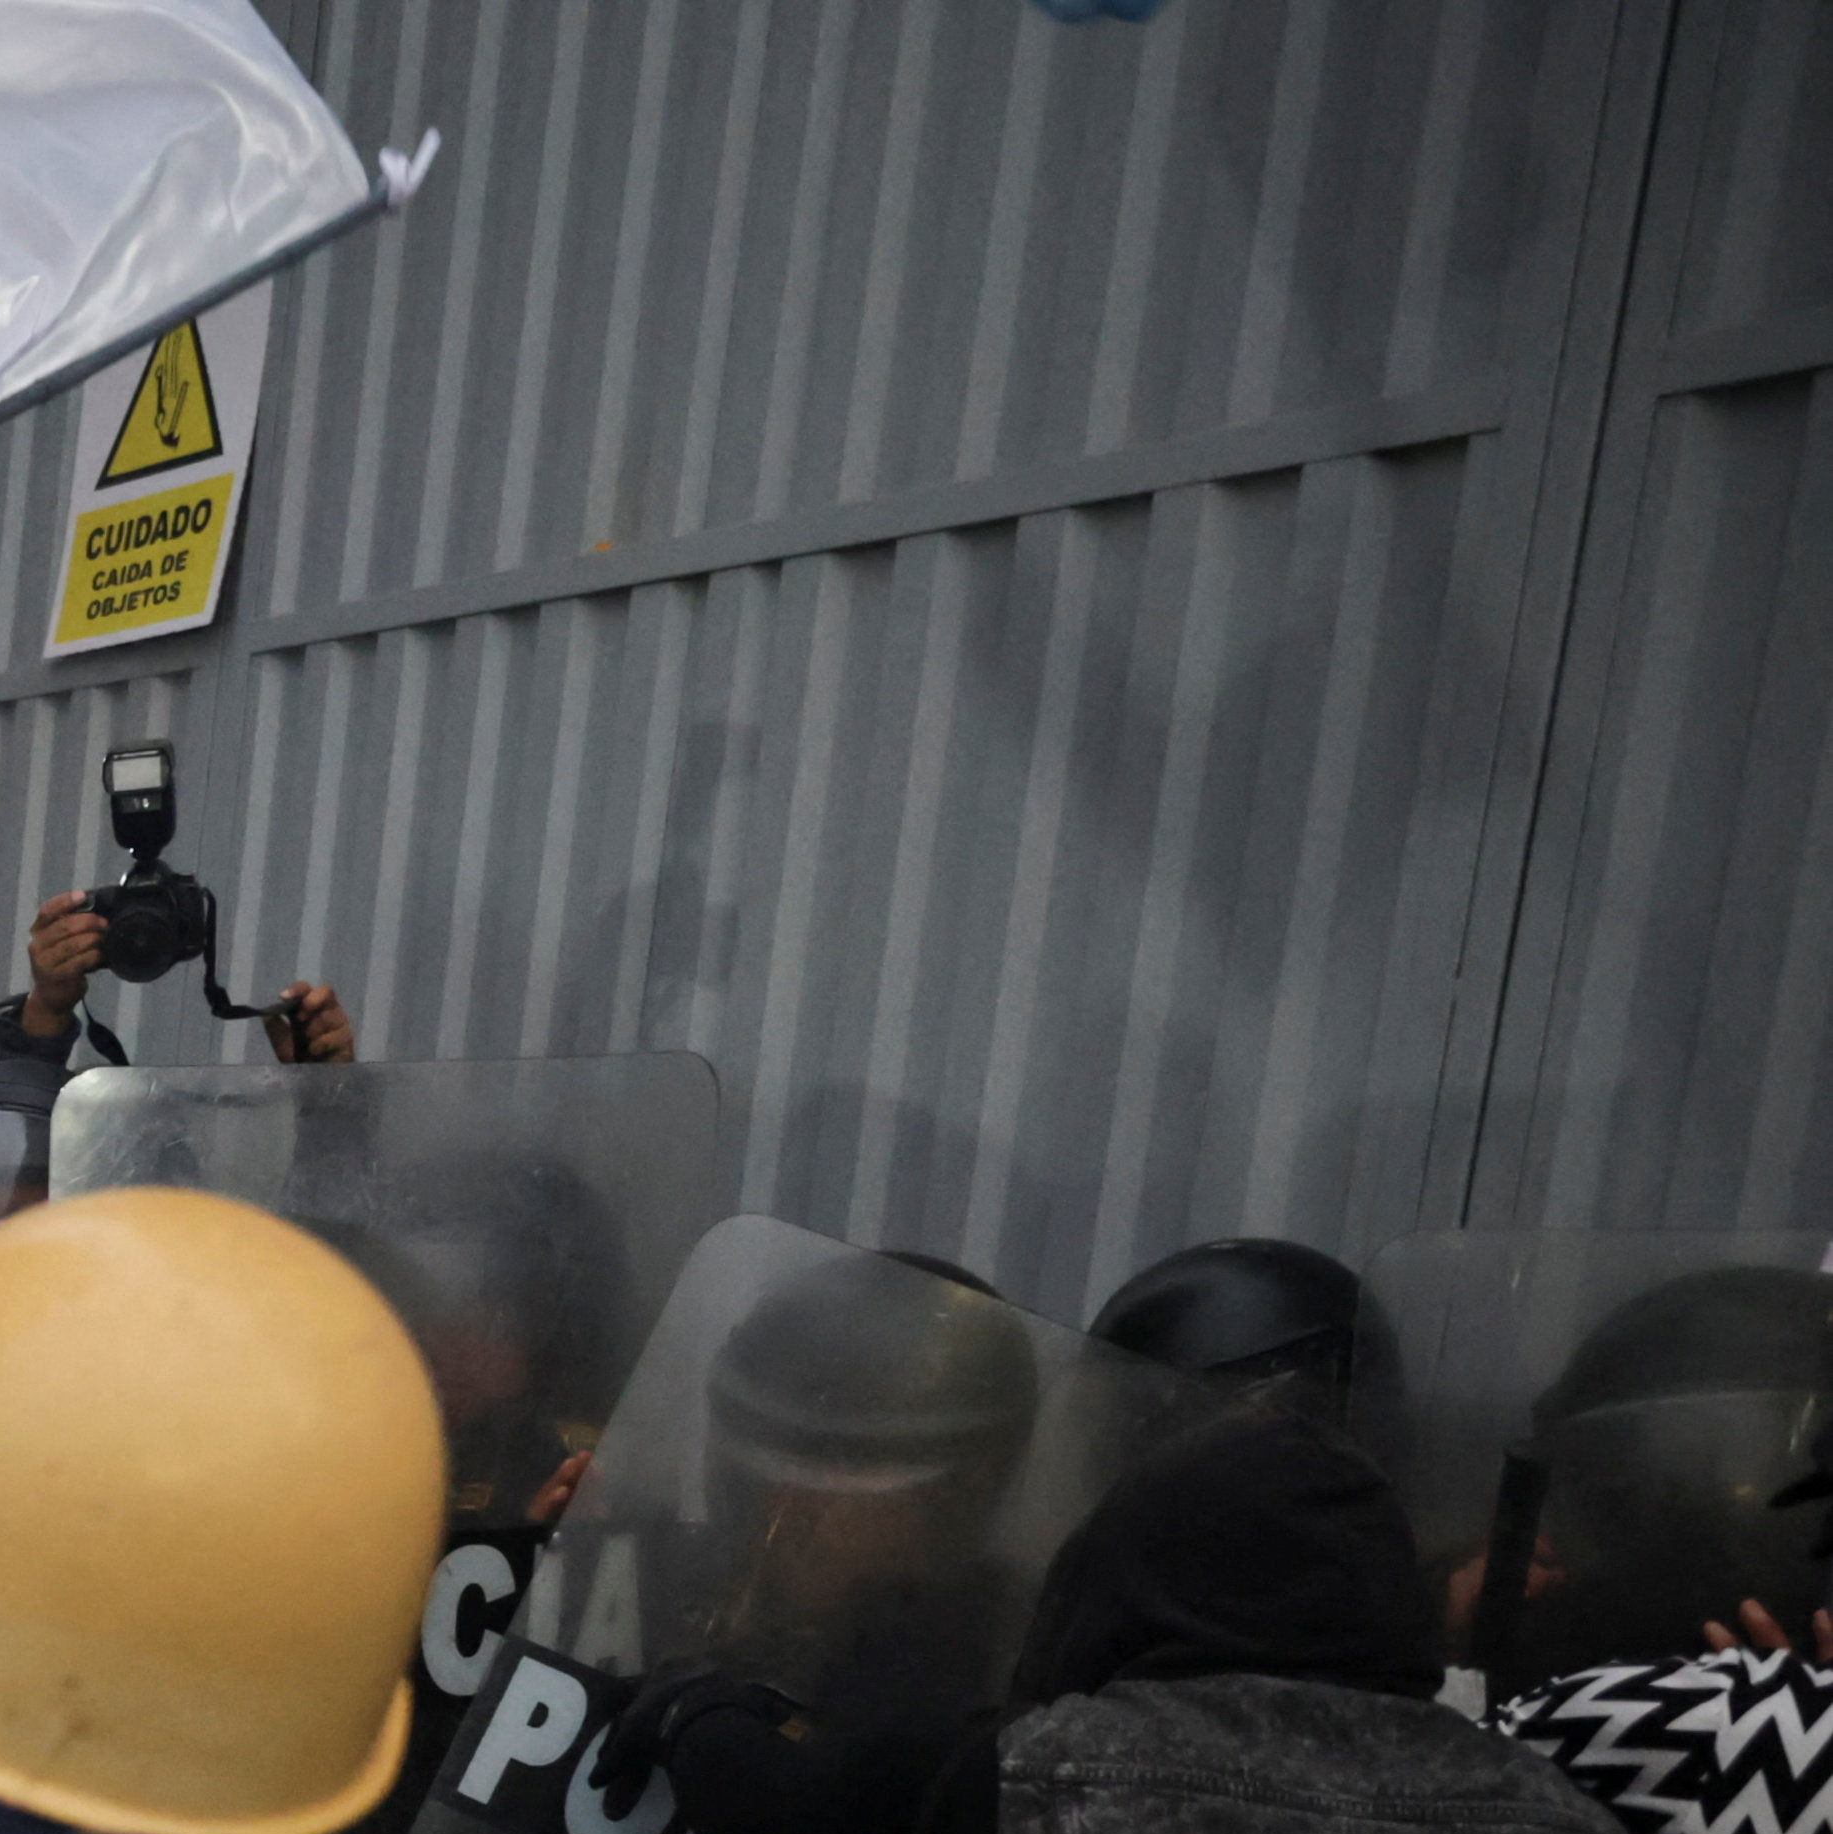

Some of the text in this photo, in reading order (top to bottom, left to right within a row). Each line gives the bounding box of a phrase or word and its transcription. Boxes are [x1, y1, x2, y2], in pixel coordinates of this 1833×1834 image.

[86, 498, 212, 560] CUIDADO
[92, 550, 189, 591] CAIDA DE
[87, 581, 181, 620] OBJETOS
